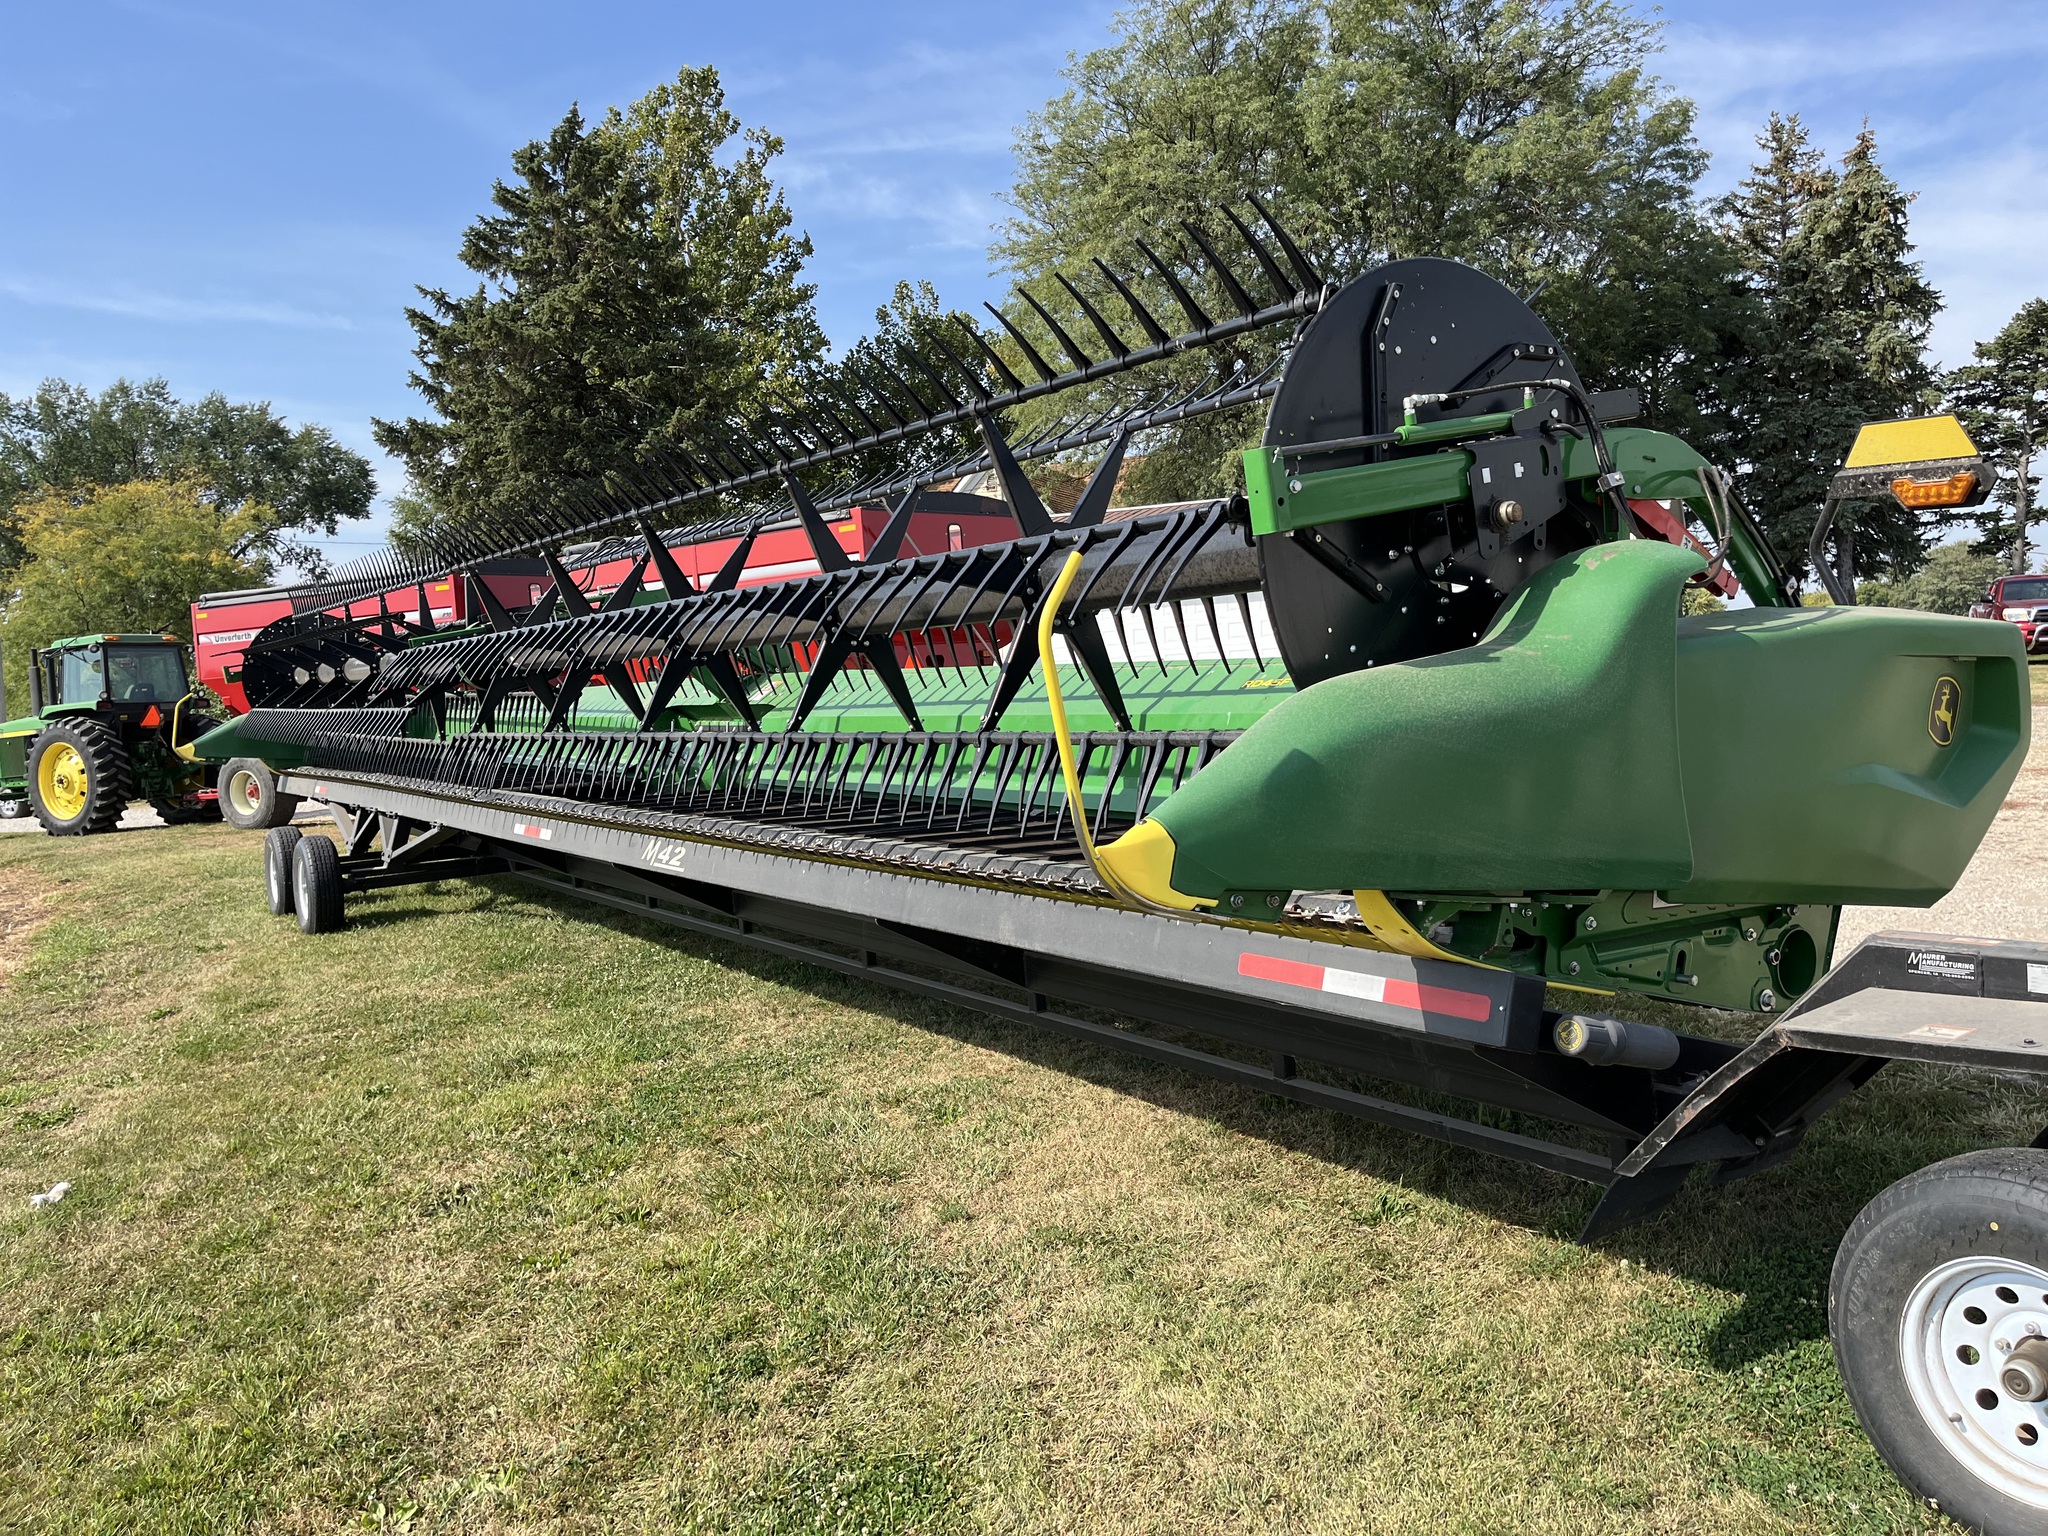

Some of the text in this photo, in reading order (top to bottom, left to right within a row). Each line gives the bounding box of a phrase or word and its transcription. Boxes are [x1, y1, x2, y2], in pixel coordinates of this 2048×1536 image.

[214, 632, 252, 643] Unverferth
[1241, 677, 1292, 688] RD45F
[641, 838, 687, 868] M42
[1908, 951, 1946, 970] MAURER
